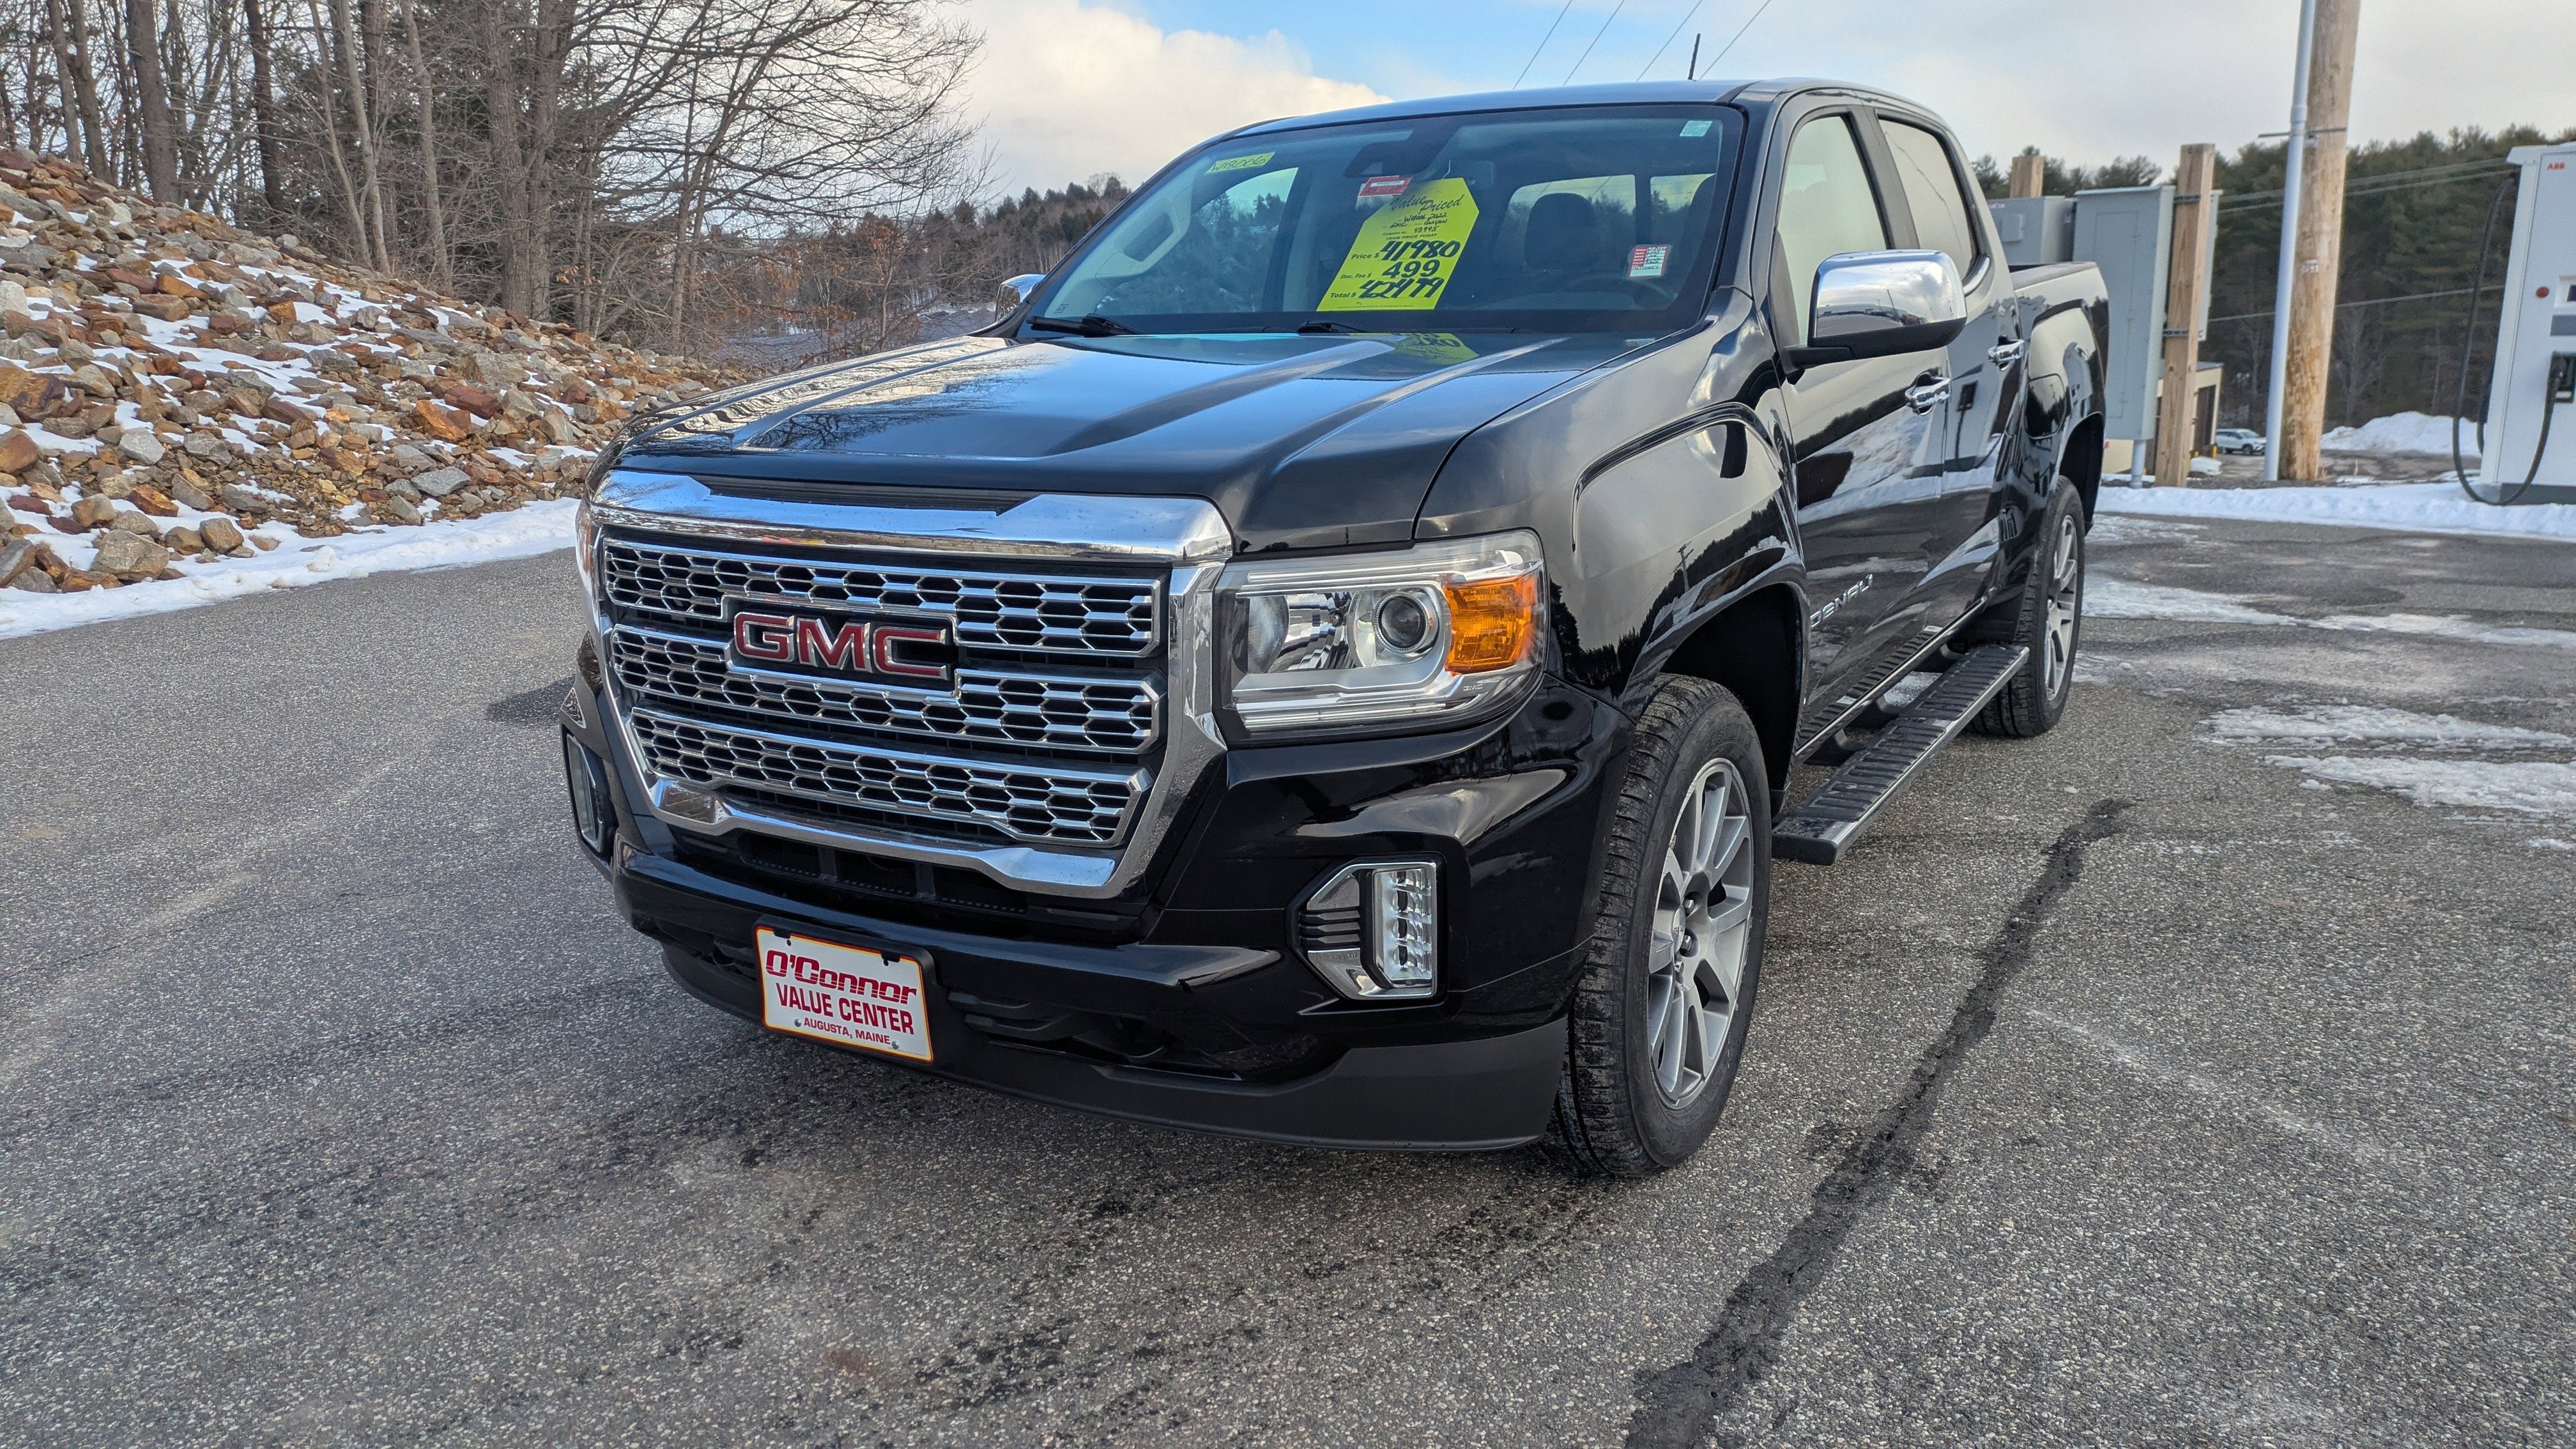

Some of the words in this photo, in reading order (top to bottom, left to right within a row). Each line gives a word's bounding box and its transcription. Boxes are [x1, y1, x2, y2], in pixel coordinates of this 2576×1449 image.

[1390, 195, 1427, 211] Value
[1418, 194, 1465, 215] Priced
[1379, 239, 1461, 262] 41980
[1381, 259, 1441, 279] 499
[1810, 574, 1873, 627] DENALI
[734, 611, 949, 681] GMC
[765, 949, 917, 1005] O'Connor
[776, 982, 834, 1018] VALUE
[838, 997, 915, 1036] CENTER
[804, 1017, 853, 1039] AUGUSTA,
[855, 1029, 891, 1045] MAINE
